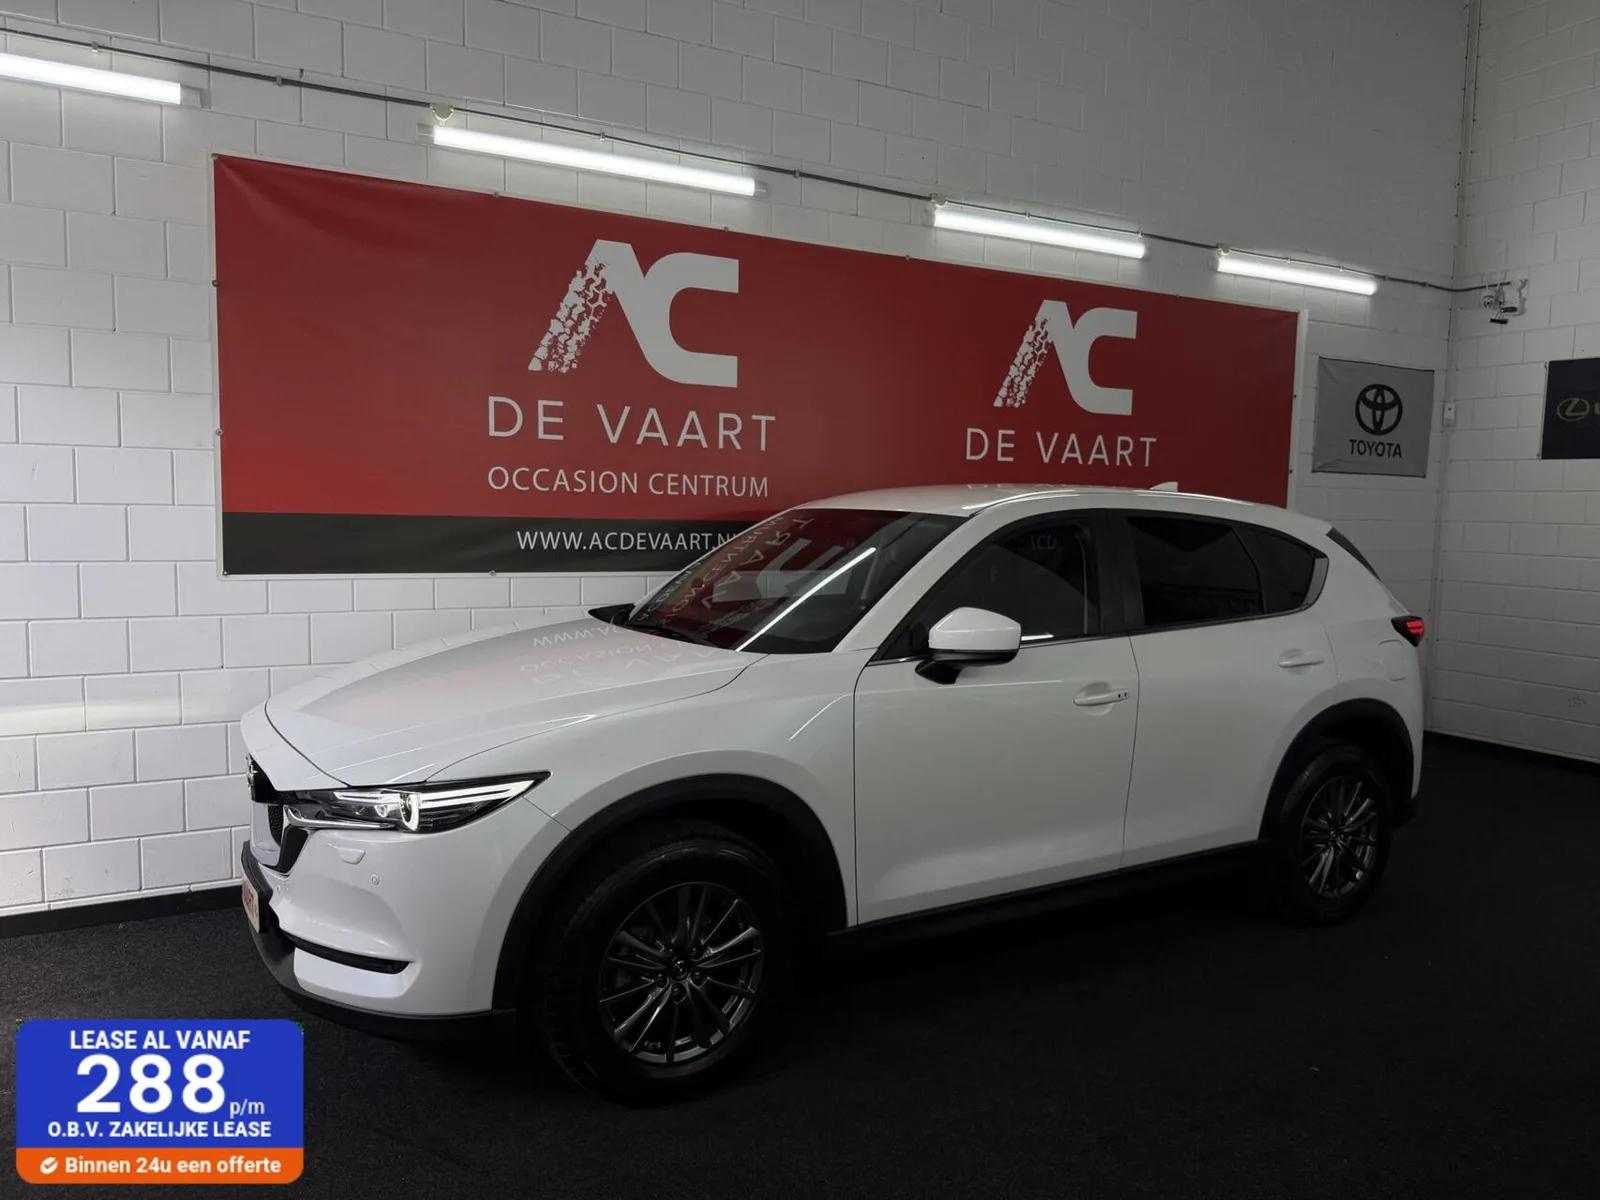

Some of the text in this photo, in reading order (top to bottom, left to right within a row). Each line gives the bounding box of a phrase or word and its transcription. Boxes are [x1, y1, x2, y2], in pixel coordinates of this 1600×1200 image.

[528, 239, 739, 388] AC
[993, 299, 1138, 416] AC
[488, 395, 776, 451] DE VAART
[965, 427, 1157, 467] DE VAART
[1349, 439, 1402, 458] TOYOTA
[488, 466, 769, 497] OCCASION CENTRUM
[516, 530, 738, 551] WWW.ACDEVAART.N
